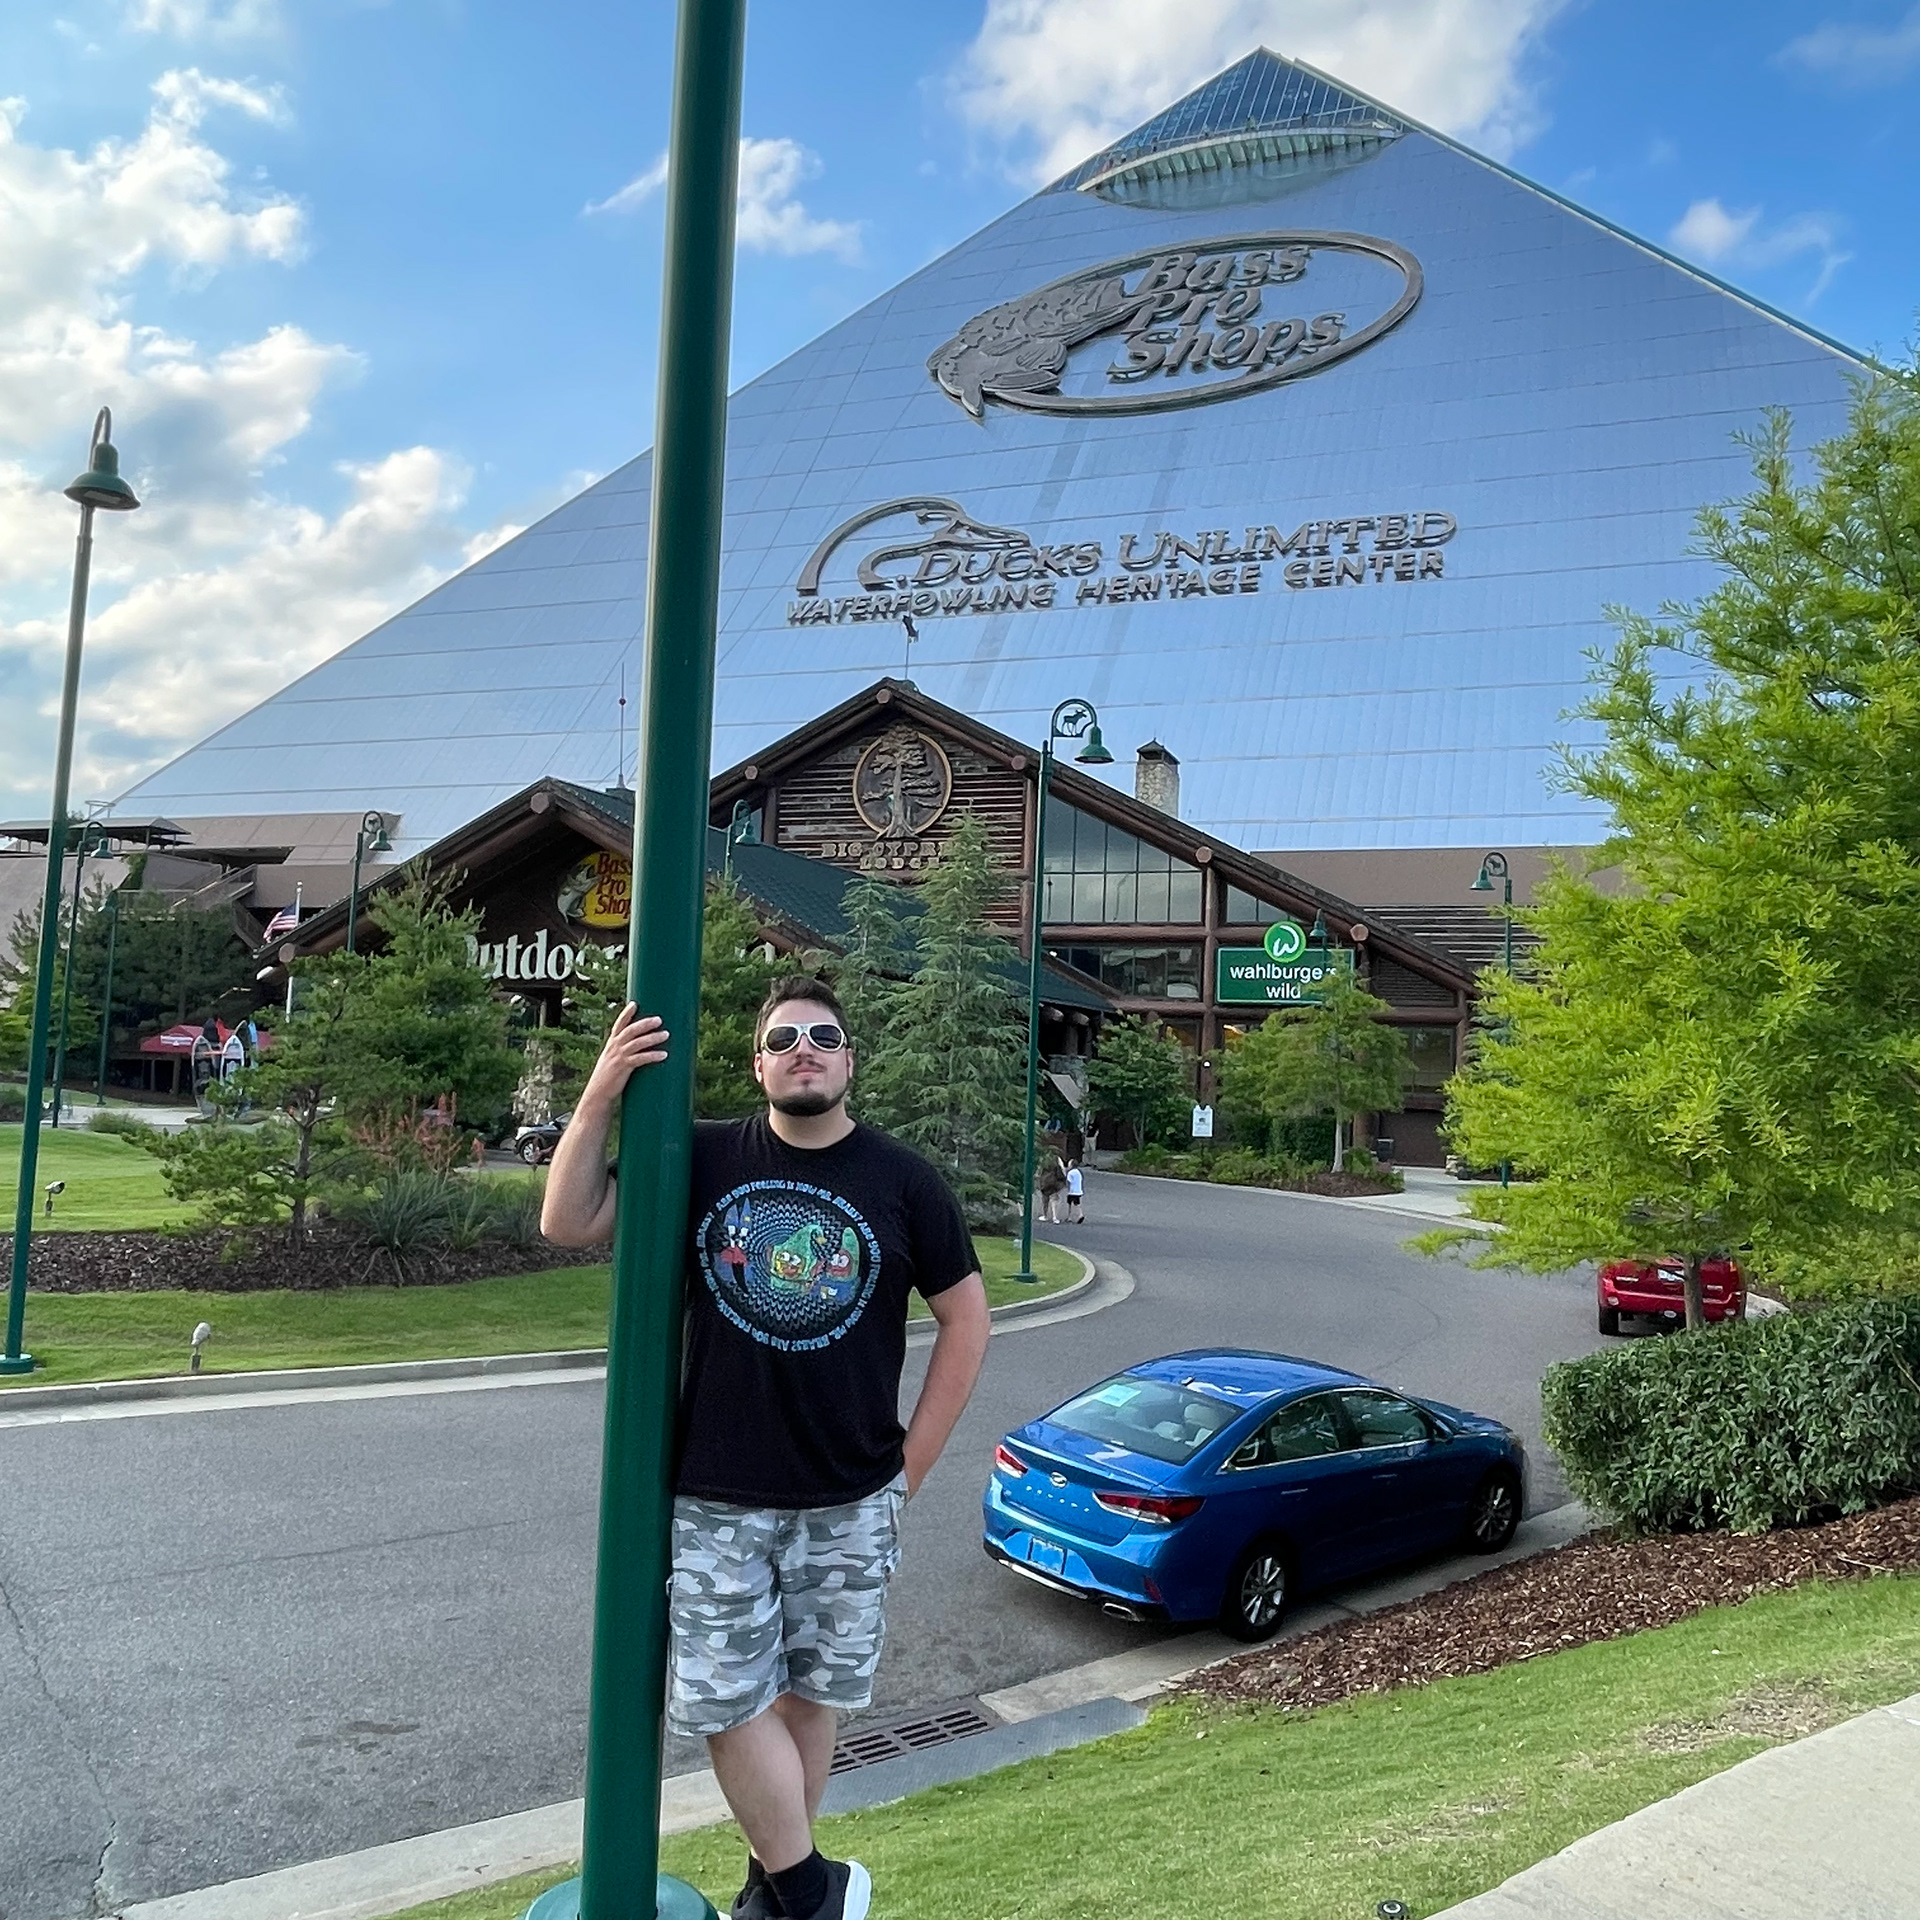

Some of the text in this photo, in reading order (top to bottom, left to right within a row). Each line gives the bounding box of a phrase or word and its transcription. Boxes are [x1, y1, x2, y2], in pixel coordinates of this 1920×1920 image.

[1124, 245, 1312, 297] Bass
[1121, 287, 1262, 336] Pro
[1106, 313, 1347, 378] Shops
[911, 511, 1457, 583] DUCKS UNLIMITED
[787, 549, 1444, 624] WATERFOWLING HERITAGE CENTER
[821, 842, 862, 858] BIG
[860, 857, 940, 871] LODGE
[596, 876, 626, 896] Pro
[1266, 983, 1301, 999] wild
